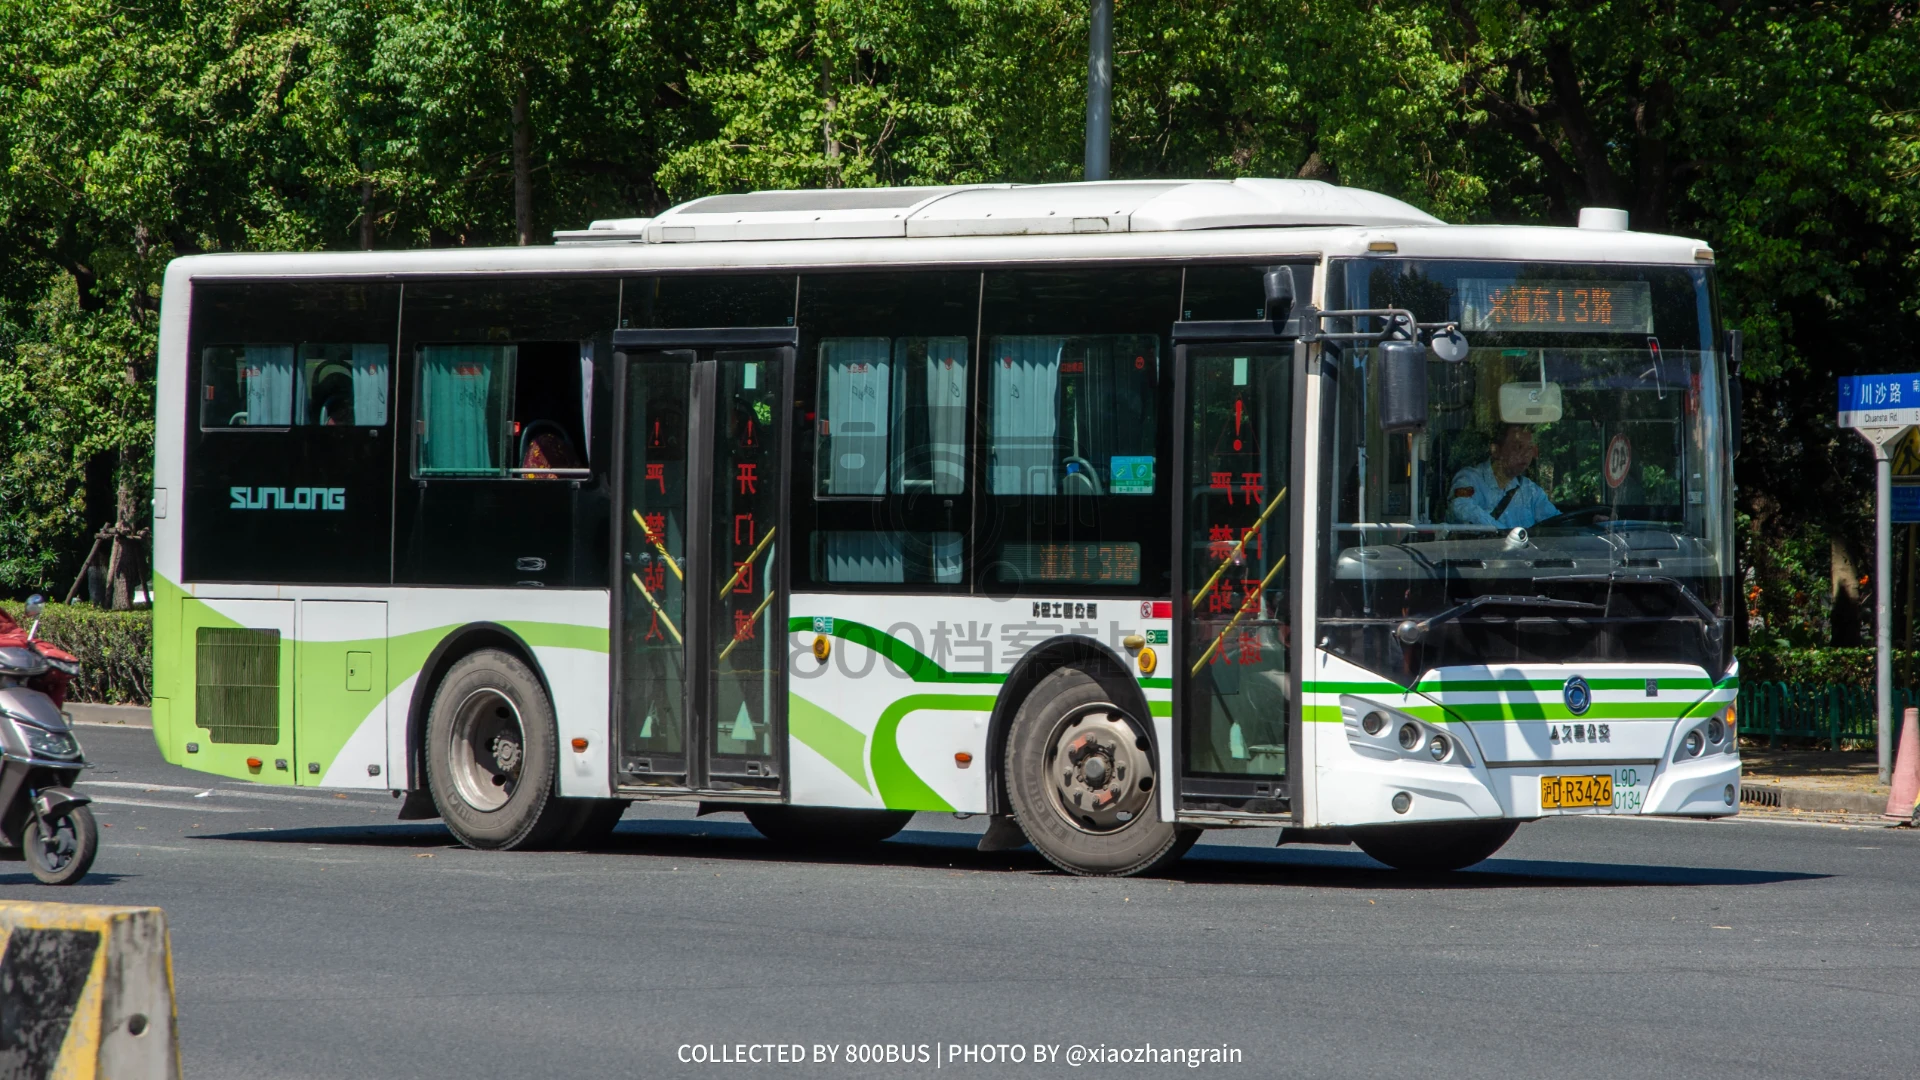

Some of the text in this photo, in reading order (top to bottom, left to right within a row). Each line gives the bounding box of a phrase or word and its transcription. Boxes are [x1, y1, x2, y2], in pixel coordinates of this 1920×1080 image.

[1860, 382, 1901, 405] 川沙路
[1864, 413, 1888, 423] Chuansha
[229, 486, 346, 510] SUNLONG
[1614, 768, 1641, 788] L9D-
[1614, 791, 1641, 810] 0134
